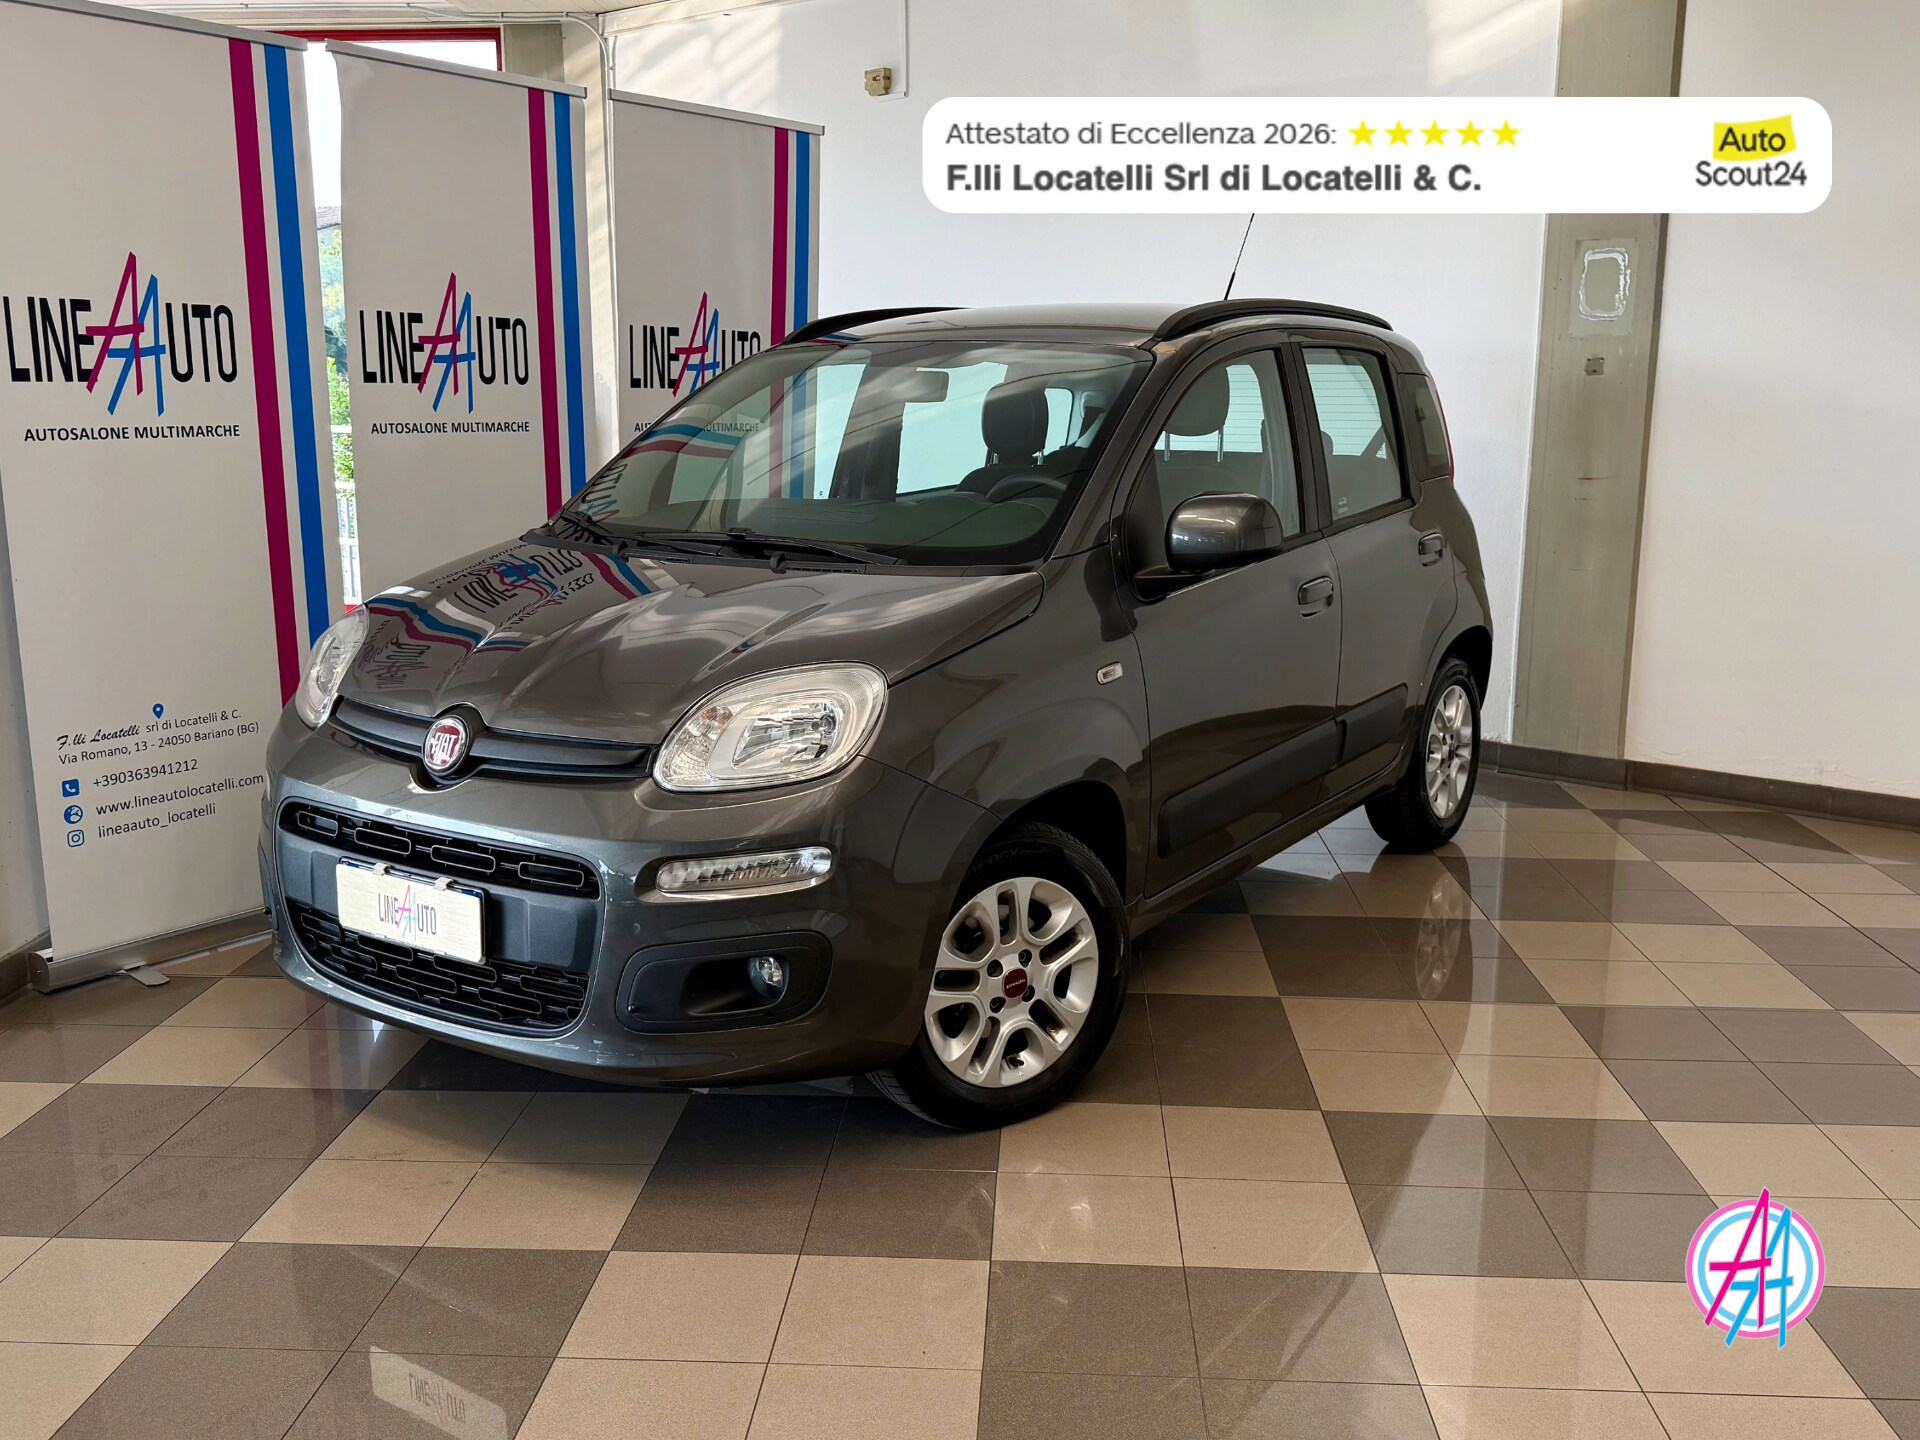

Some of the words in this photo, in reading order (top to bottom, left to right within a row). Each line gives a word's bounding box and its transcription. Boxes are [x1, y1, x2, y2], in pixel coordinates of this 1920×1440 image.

[24, 427, 130, 442] AUTOSALONE
[134, 424, 241, 440] MULTIMARCHE
[371, 422, 448, 435] AUTOSALONE
[451, 421, 530, 433] MULTIMARCHE
[56, 733, 86, 751] F.lli
[90, 724, 141, 743] Locatelli
[146, 720, 159, 732] srl
[162, 718, 172, 731] di
[174, 712, 218, 729] Locatelli
[220, 710, 229, 720] &
[231, 709, 242, 719] C.
[59, 753, 78, 765] Via
[81, 745, 132, 762] Romano,
[134, 741, 148, 752] 13
[158, 733, 192, 749] 24050
[194, 727, 235, 742] Bariano
[237, 722, 260, 737] (BG)
[431, 731, 458, 759] FIAT
[93, 758, 199, 789] +390363941212
[96, 774, 265, 816] www.lineautolocatelli.com
[98, 802, 217, 839] lineaauto_locatelli
